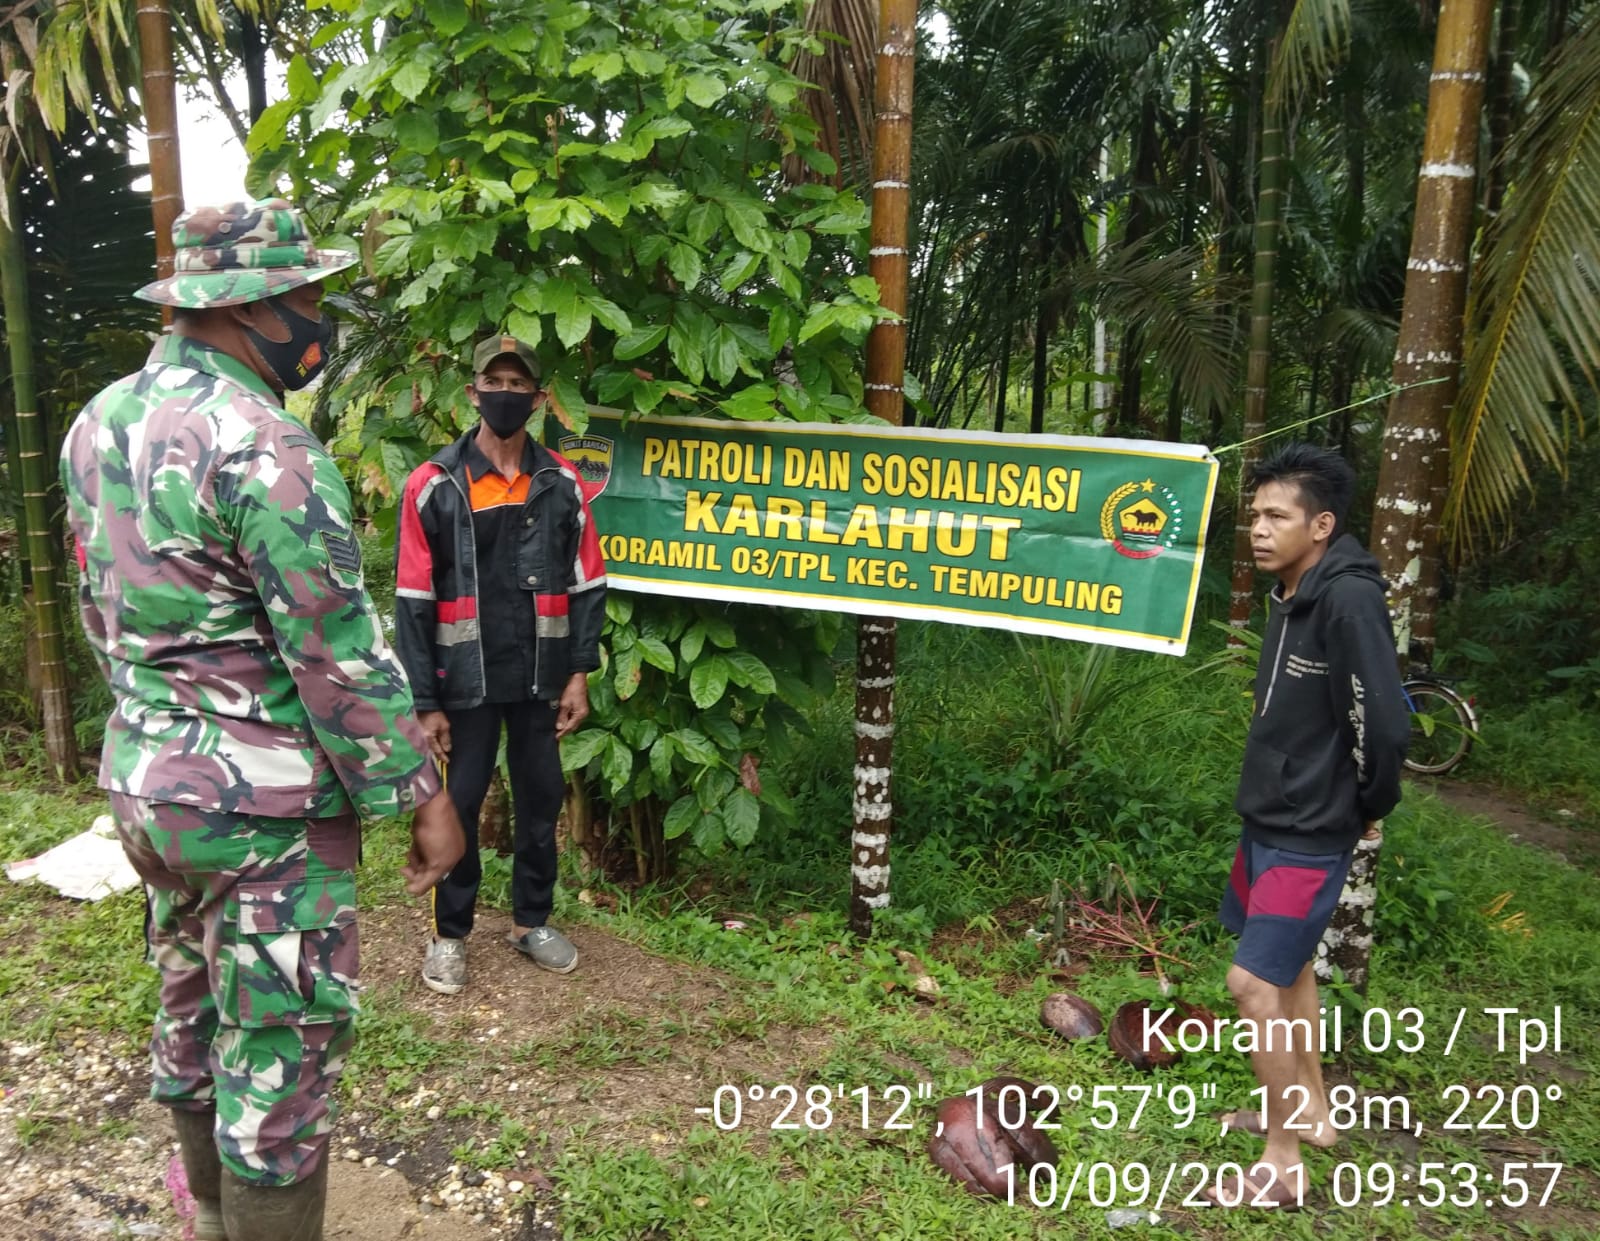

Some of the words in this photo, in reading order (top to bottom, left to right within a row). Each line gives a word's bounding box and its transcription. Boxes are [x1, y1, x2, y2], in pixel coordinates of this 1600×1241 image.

[642, 437, 772, 485] PATROLI
[783, 447, 850, 491] DAN
[861, 452, 1082, 513] SOSIALISASI
[684, 490, 1022, 561] KARLAHUT
[731, 547, 837, 582] 03/TPL
[846, 556, 918, 590] KEC.
[929, 565, 1123, 615] TEMPULING
